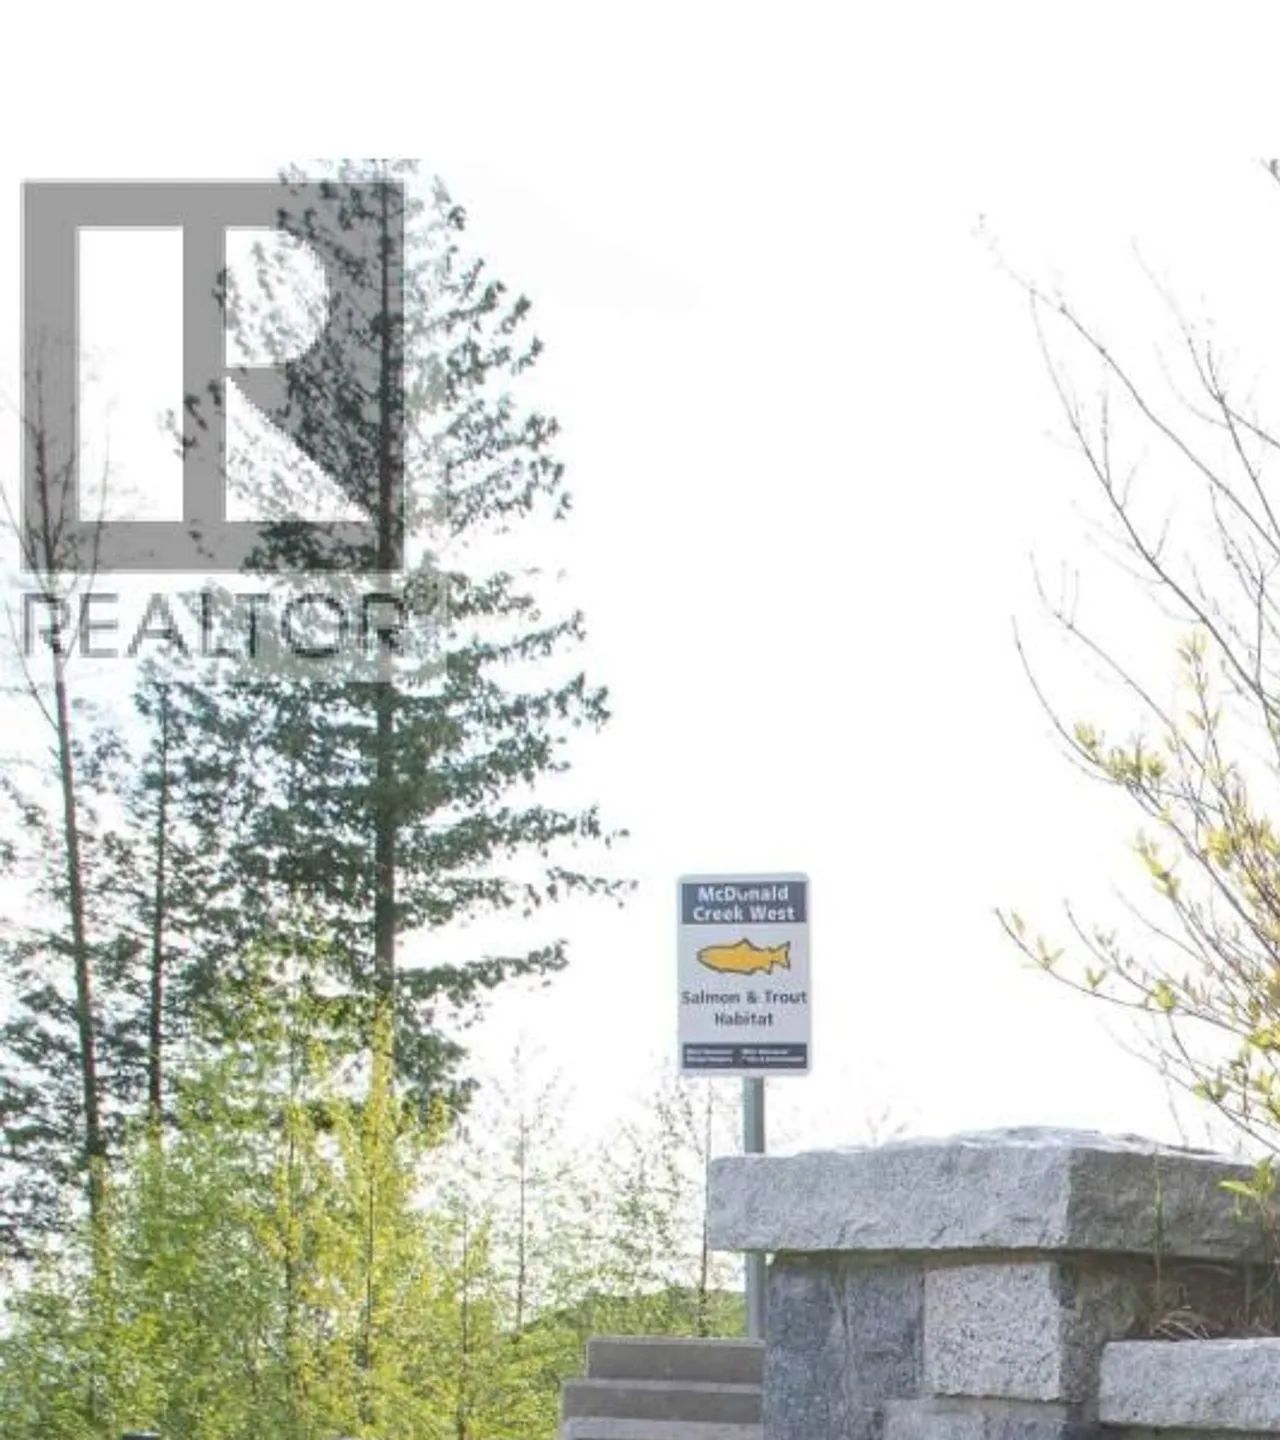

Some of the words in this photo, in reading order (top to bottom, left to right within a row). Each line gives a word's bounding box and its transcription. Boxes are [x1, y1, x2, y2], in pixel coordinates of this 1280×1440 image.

[698, 885, 789, 902] McDonald
[693, 906, 743, 922] Creek
[750, 905, 796, 921] West
[681, 990, 740, 1005] Salmon
[746, 991, 759, 1005] &
[765, 990, 807, 1005] Trout
[714, 1012, 774, 1027] Habitat
